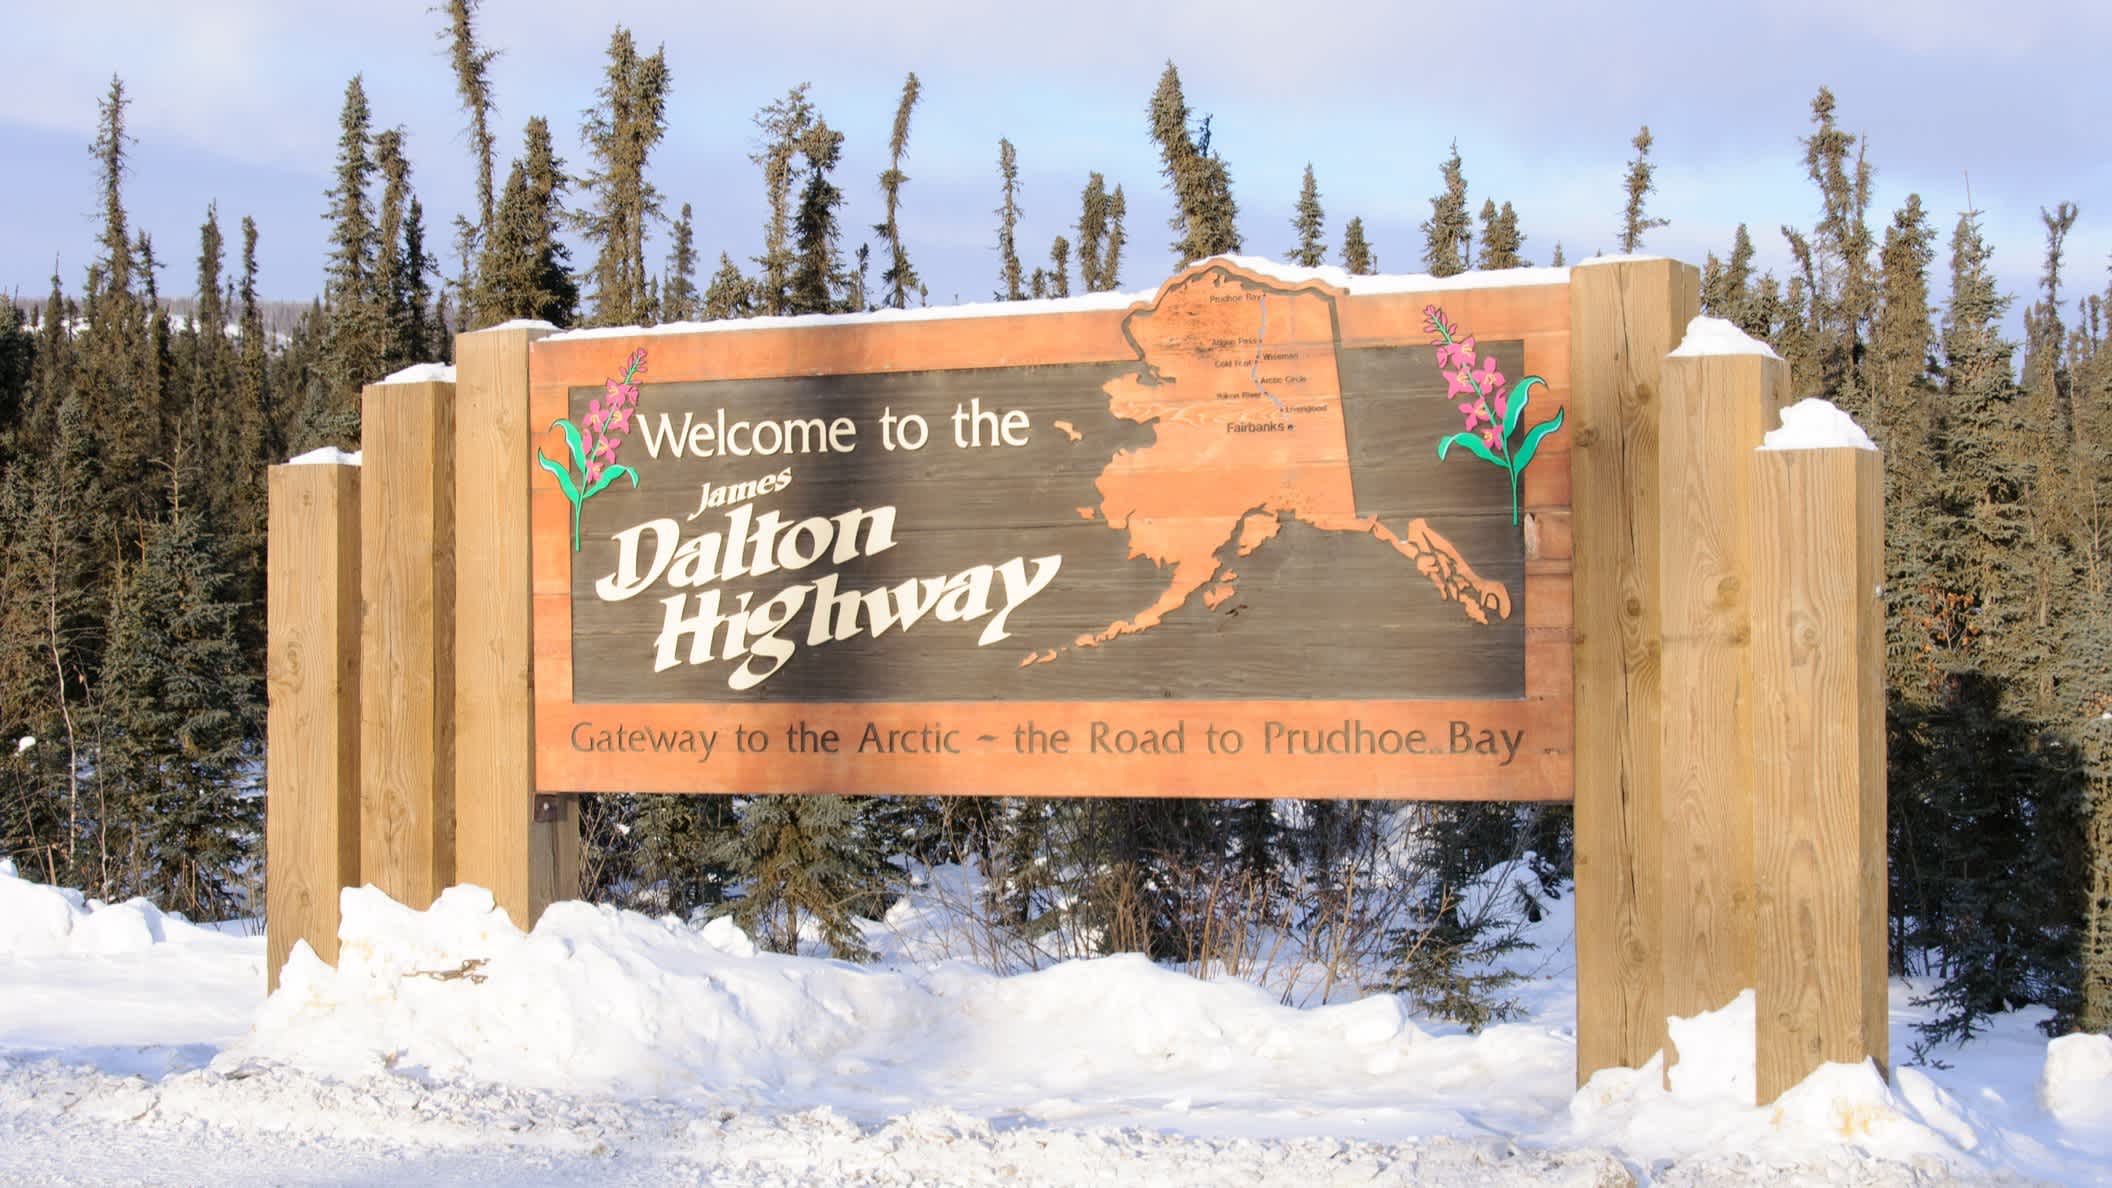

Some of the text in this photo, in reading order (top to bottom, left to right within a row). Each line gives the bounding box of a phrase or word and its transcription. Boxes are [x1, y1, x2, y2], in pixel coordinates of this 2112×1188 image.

[636, 398, 1030, 459] Welcome to the
[1227, 421, 1284, 433] Fairbanks
[688, 467, 793, 522] James
[595, 503, 897, 602] Dalton
[654, 554, 1063, 691] Highway
[571, 720, 717, 763] Gateway
[736, 722, 769, 753] to
[786, 720, 840, 753] the
[857, 720, 961, 754] Arctic
[1014, 720, 1069, 754] the
[1090, 720, 1185, 754] Road
[1206, 723, 1243, 754] to
[1263, 720, 1427, 755] Prudhoe
[1448, 720, 1526, 766] Bay
